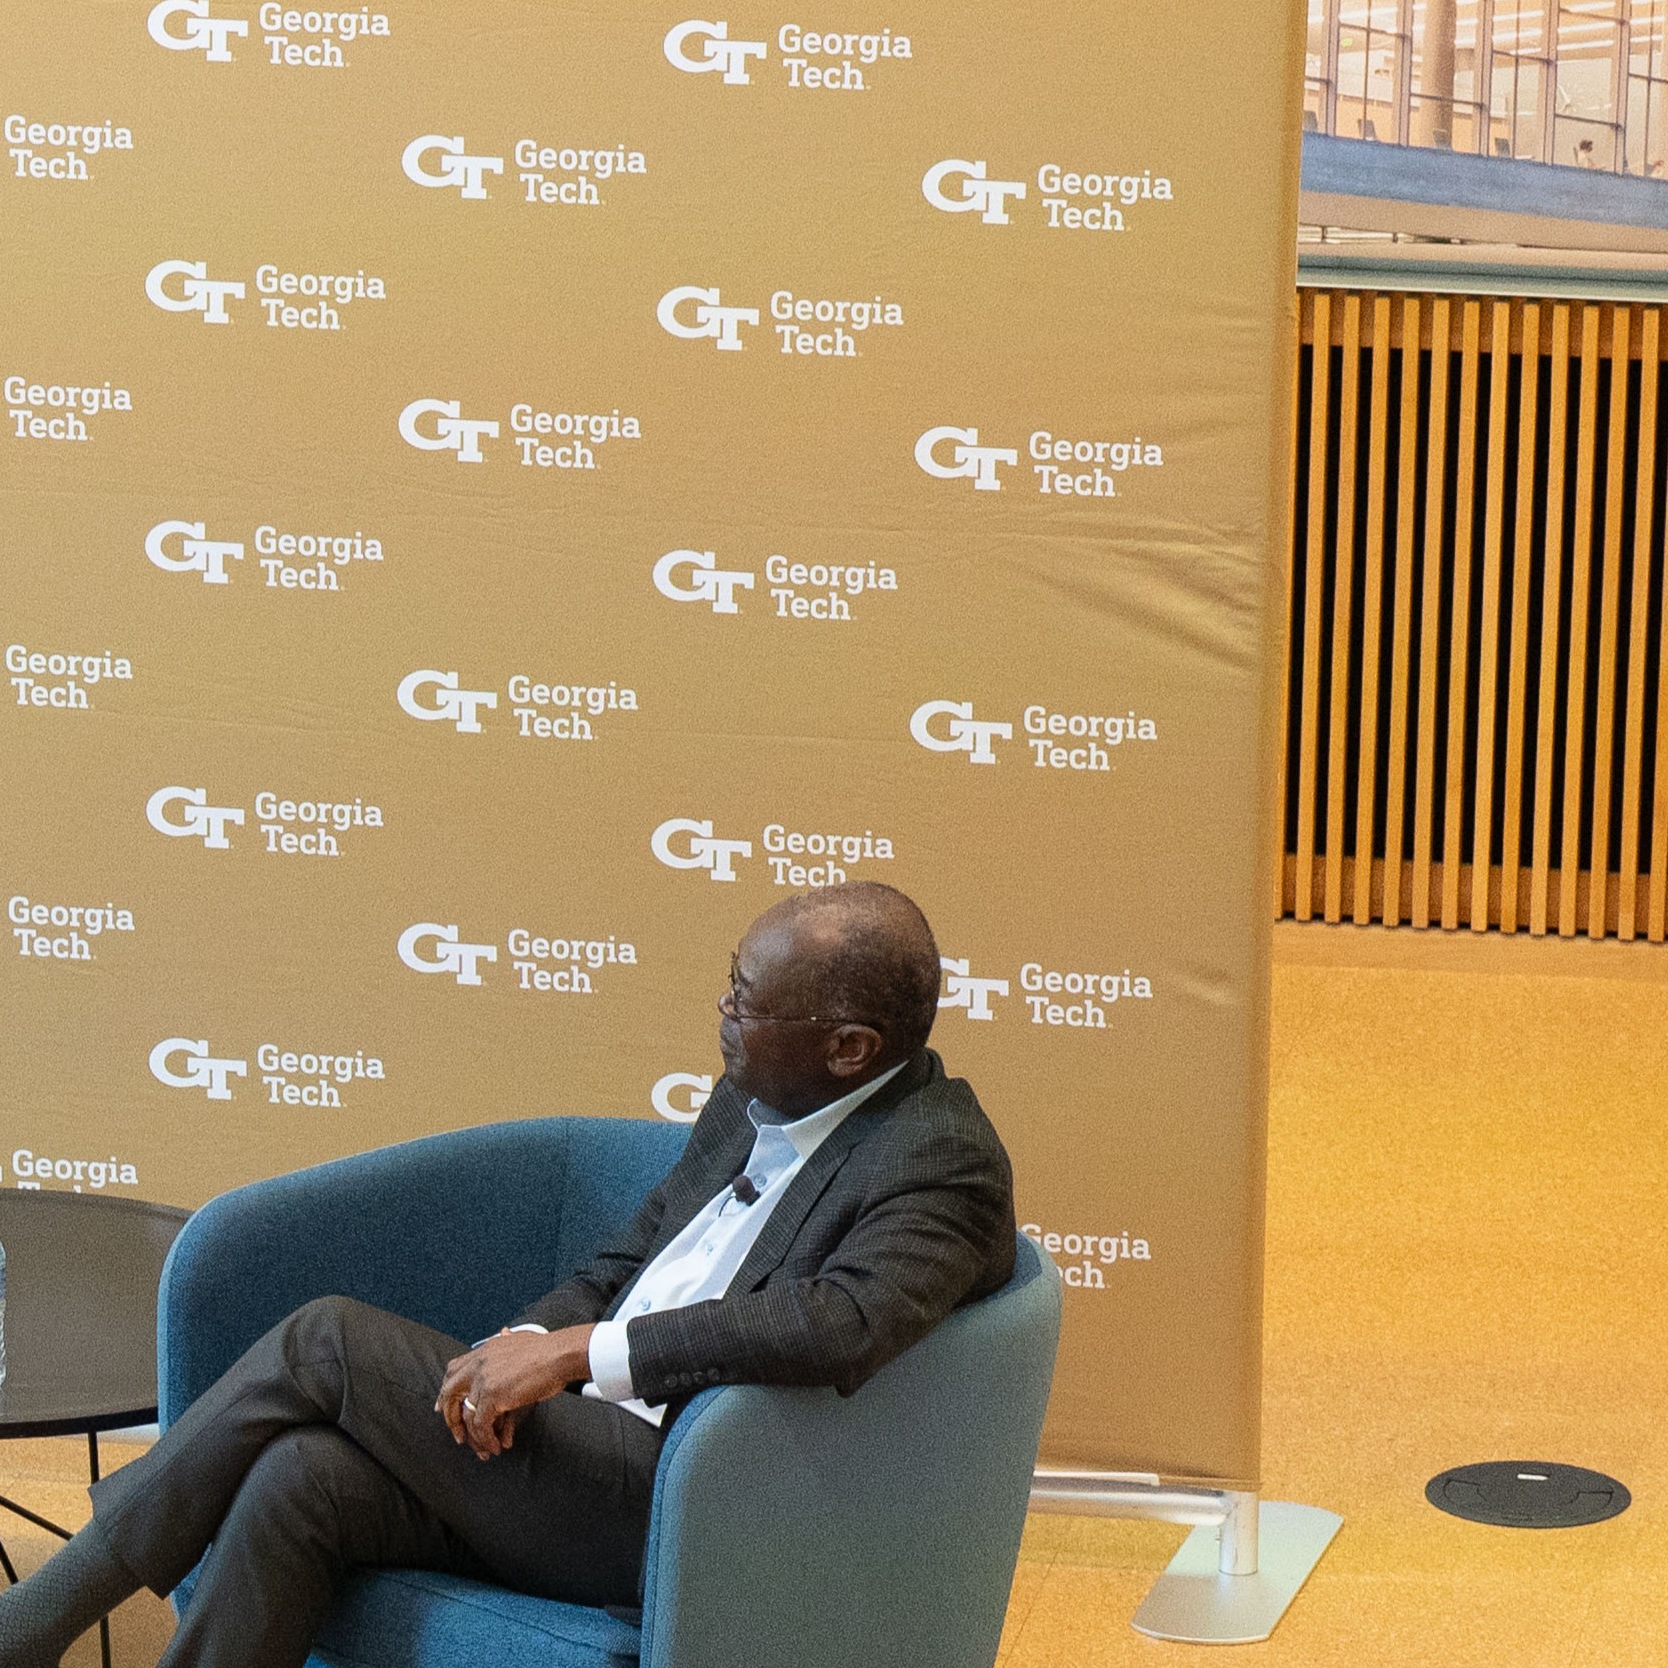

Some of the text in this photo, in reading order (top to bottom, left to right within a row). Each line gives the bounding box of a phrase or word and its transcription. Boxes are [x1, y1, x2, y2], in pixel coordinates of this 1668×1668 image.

[147, 0, 248, 62] GT
[259, 2, 389, 41] Georgia
[264, 35, 343, 67] Tech
[663, 20, 766, 84] GT
[778, 24, 910, 63] Georgia
[783, 58, 863, 90] Tech
[4, 115, 132, 154] Georgia
[9, 148, 87, 180] Tech
[401, 135, 504, 199] GT
[515, 140, 646, 179] Georgia
[519, 173, 598, 205] Tech
[922, 159, 1025, 224] GT
[1037, 164, 1172, 205] Georgia
[1042, 198, 1123, 231] Tech
[145, 260, 245, 324] GT
[255, 264, 385, 304] Georgia
[261, 298, 339, 330] Tech
[657, 286, 759, 350] GT
[770, 291, 902, 330] Georgia
[774, 325, 855, 356] Tech
[4, 376, 132, 415] Georgia
[9, 409, 86, 441] Tech
[398, 399, 499, 463] GT
[510, 404, 640, 443] Georgia
[515, 437, 595, 469] Tech
[915, 426, 1017, 490] GT
[1029, 431, 1162, 470] Georgia
[1033, 465, 1115, 496] Tech
[145, 520, 244, 584] GT
[254, 525, 382, 565] Georgia
[260, 558, 338, 590] Tech
[653, 550, 754, 613] GT
[765, 555, 897, 594] Georgia
[771, 589, 849, 620] Tech
[5, 644, 132, 683] Georgia
[11, 677, 88, 708] Tech
[397, 670, 497, 733] GT
[508, 675, 637, 714] Georgia
[513, 708, 592, 739] Tech
[910, 701, 1012, 763] GT
[1023, 705, 1156, 745] Georgia
[1028, 739, 1108, 770] Tech
[146, 786, 244, 849] GT
[255, 792, 383, 831] Georgia
[260, 824, 338, 856] Tech
[651, 819, 751, 881] GT
[763, 825, 892, 863] Georgia
[768, 857, 845, 887] Tech
[8, 896, 134, 935] Georgia
[13, 927, 90, 960] Tech
[397, 923, 497, 985] GT
[508, 929, 636, 968] Georgia
[513, 961, 591, 992] Tech
[1021, 964, 1152, 1002] Georgia
[1026, 996, 1105, 1027] Tech
[149, 1038, 247, 1100] GT
[256, 1043, 384, 1082] Georgia
[262, 1075, 339, 1107] Tech
[651, 1073, 712, 1123] G
[13, 1149, 138, 1188] Georgia
[1059, 1261, 1105, 1288] ch
